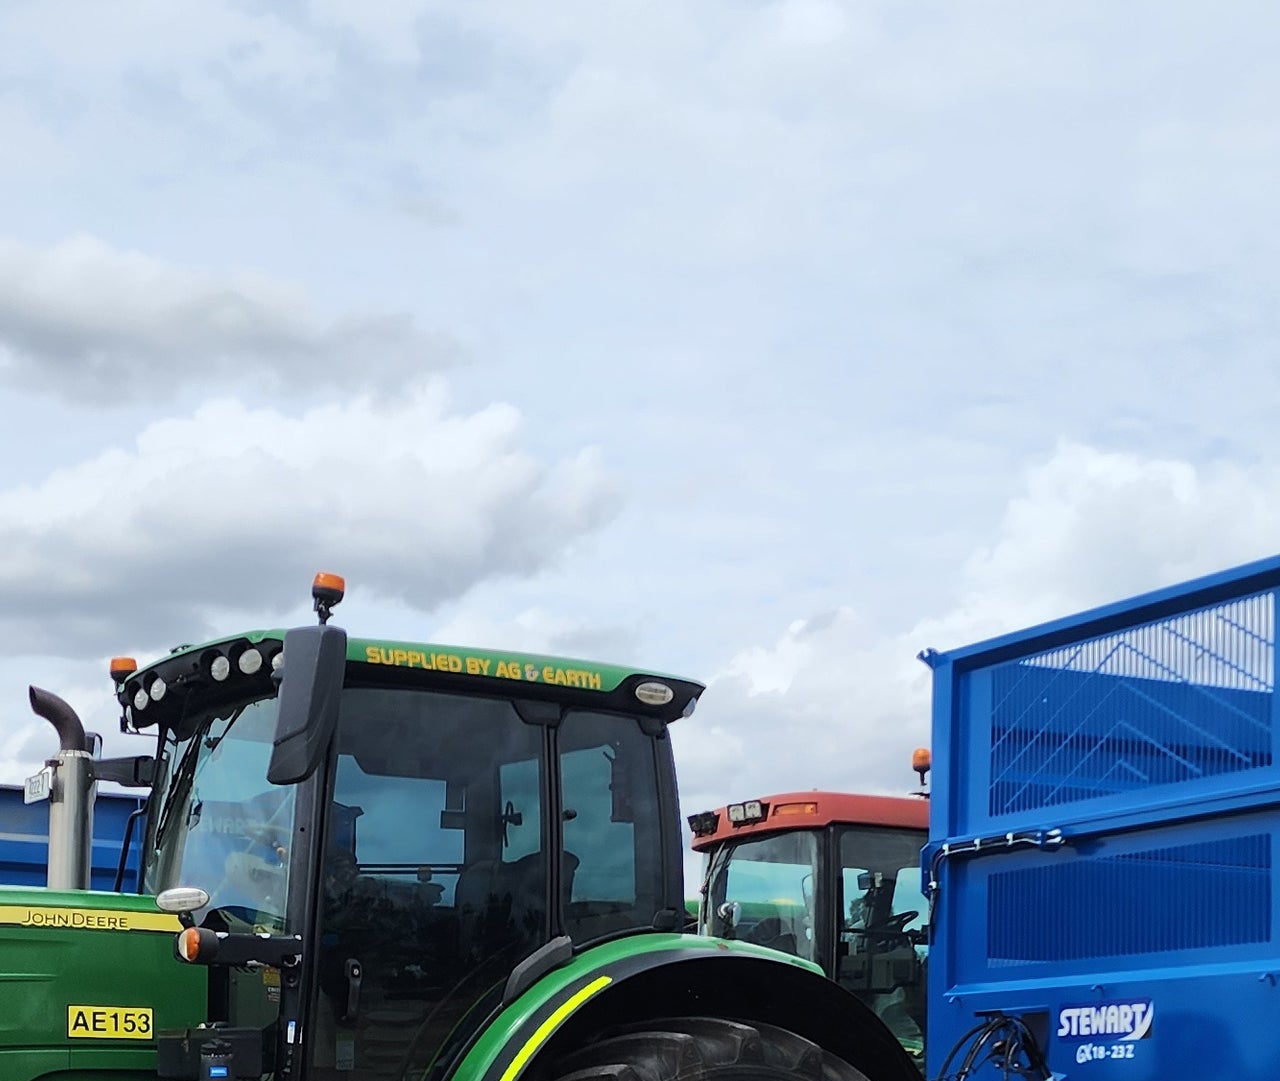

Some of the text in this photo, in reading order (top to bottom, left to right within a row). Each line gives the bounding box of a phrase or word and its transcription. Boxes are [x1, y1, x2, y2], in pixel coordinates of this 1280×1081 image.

[366, 646, 601, 690] SUPPLIED BY AG & EARTH
[22, 910, 128, 928] JOHN DEERE
[72, 1011, 150, 1033] AE153
[1058, 1000, 1154, 1041] STEWART
